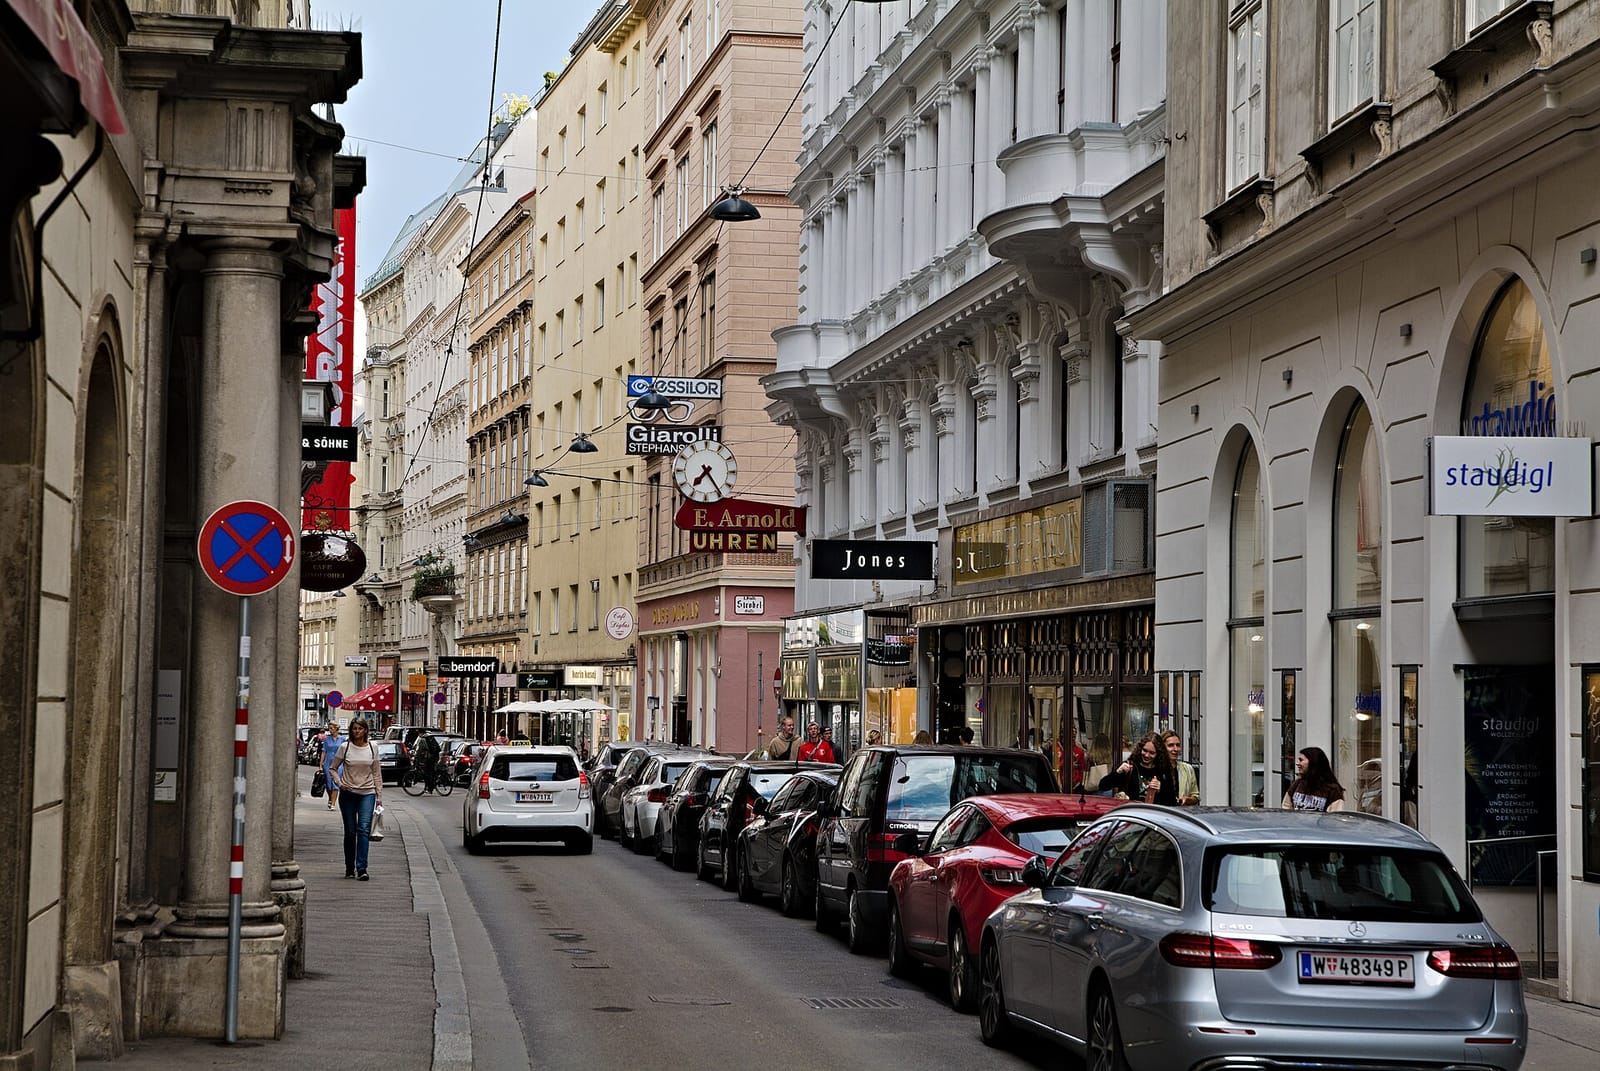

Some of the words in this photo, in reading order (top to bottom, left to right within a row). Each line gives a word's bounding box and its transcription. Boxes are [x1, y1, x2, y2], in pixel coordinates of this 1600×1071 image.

[629, 425, 719, 442] Giarolli
[302, 438, 311, 448] &
[314, 437, 349, 449] SÖHNE
[1446, 461, 1553, 493] staudigl
[693, 508, 715, 528] E.
[719, 508, 796, 528] Arnold
[693, 532, 777, 550] UHREN
[842, 550, 905, 571] Jones
[736, 599, 762, 609] Strobel
[451, 661, 496, 672] berndorf
[1482, 716, 1540, 734] staudigl
[1314, 955, 1327, 973] W
